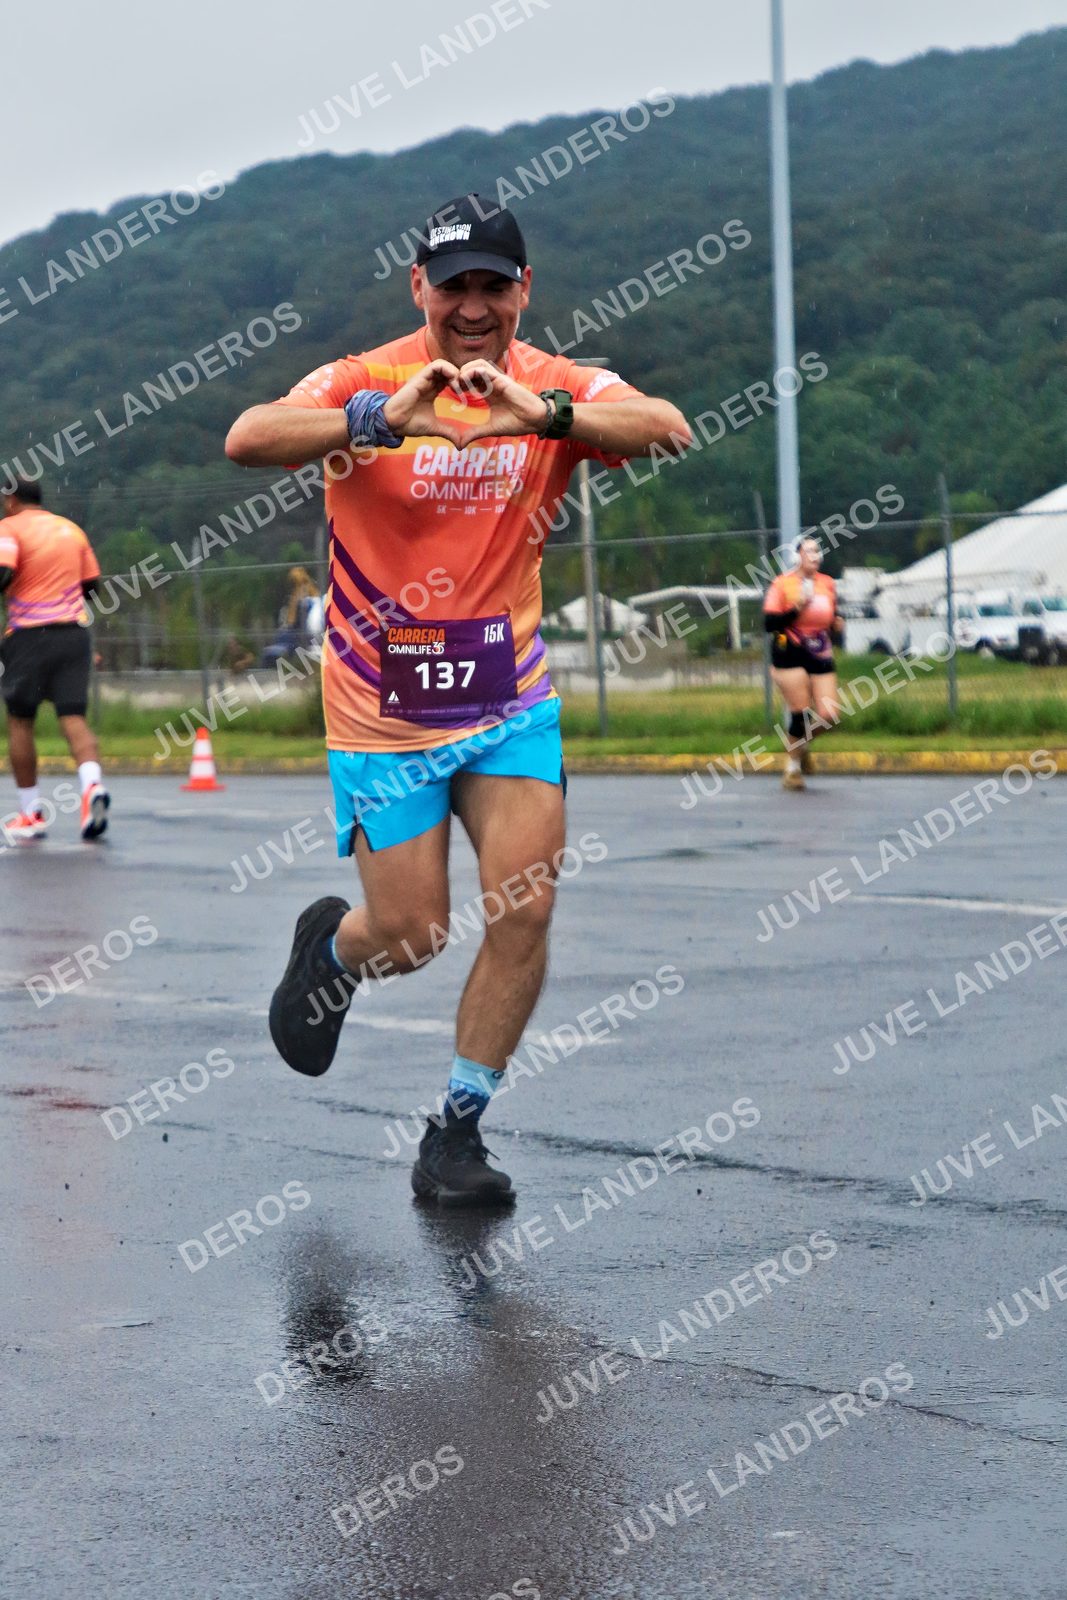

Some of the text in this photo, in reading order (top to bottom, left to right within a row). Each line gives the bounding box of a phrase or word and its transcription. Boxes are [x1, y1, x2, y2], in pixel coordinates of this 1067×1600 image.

[388, 627, 446, 644] CARRERA
[484, 622, 505, 644] 15K
[414, 661, 476, 690] 137
